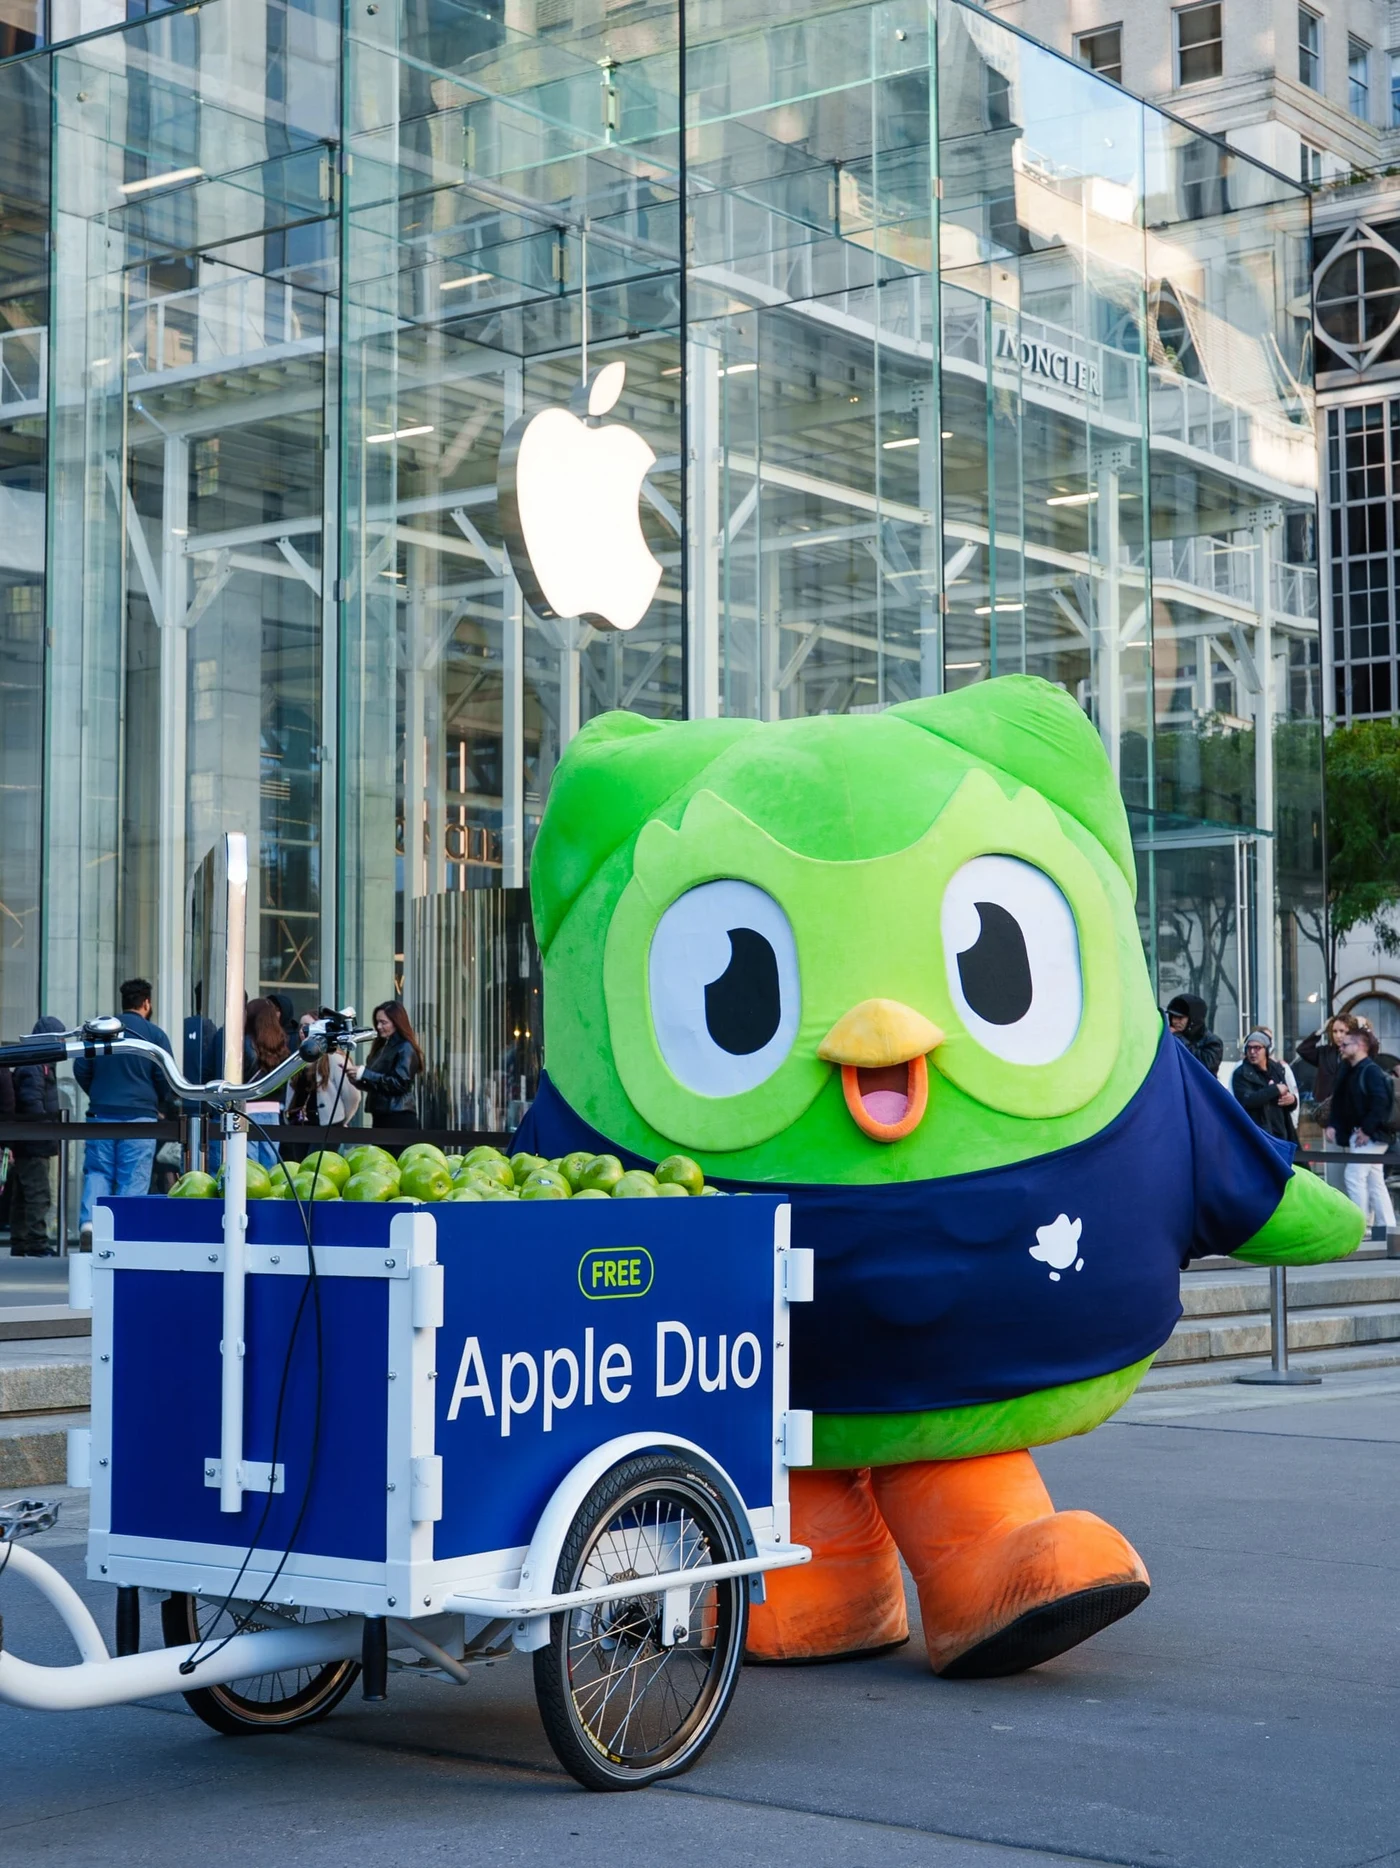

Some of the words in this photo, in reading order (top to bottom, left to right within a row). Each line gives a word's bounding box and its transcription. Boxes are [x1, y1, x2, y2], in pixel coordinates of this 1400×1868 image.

[592, 1259, 641, 1288] FREE
[447, 1327, 633, 1437] Apple
[656, 1320, 762, 1397] Duo
